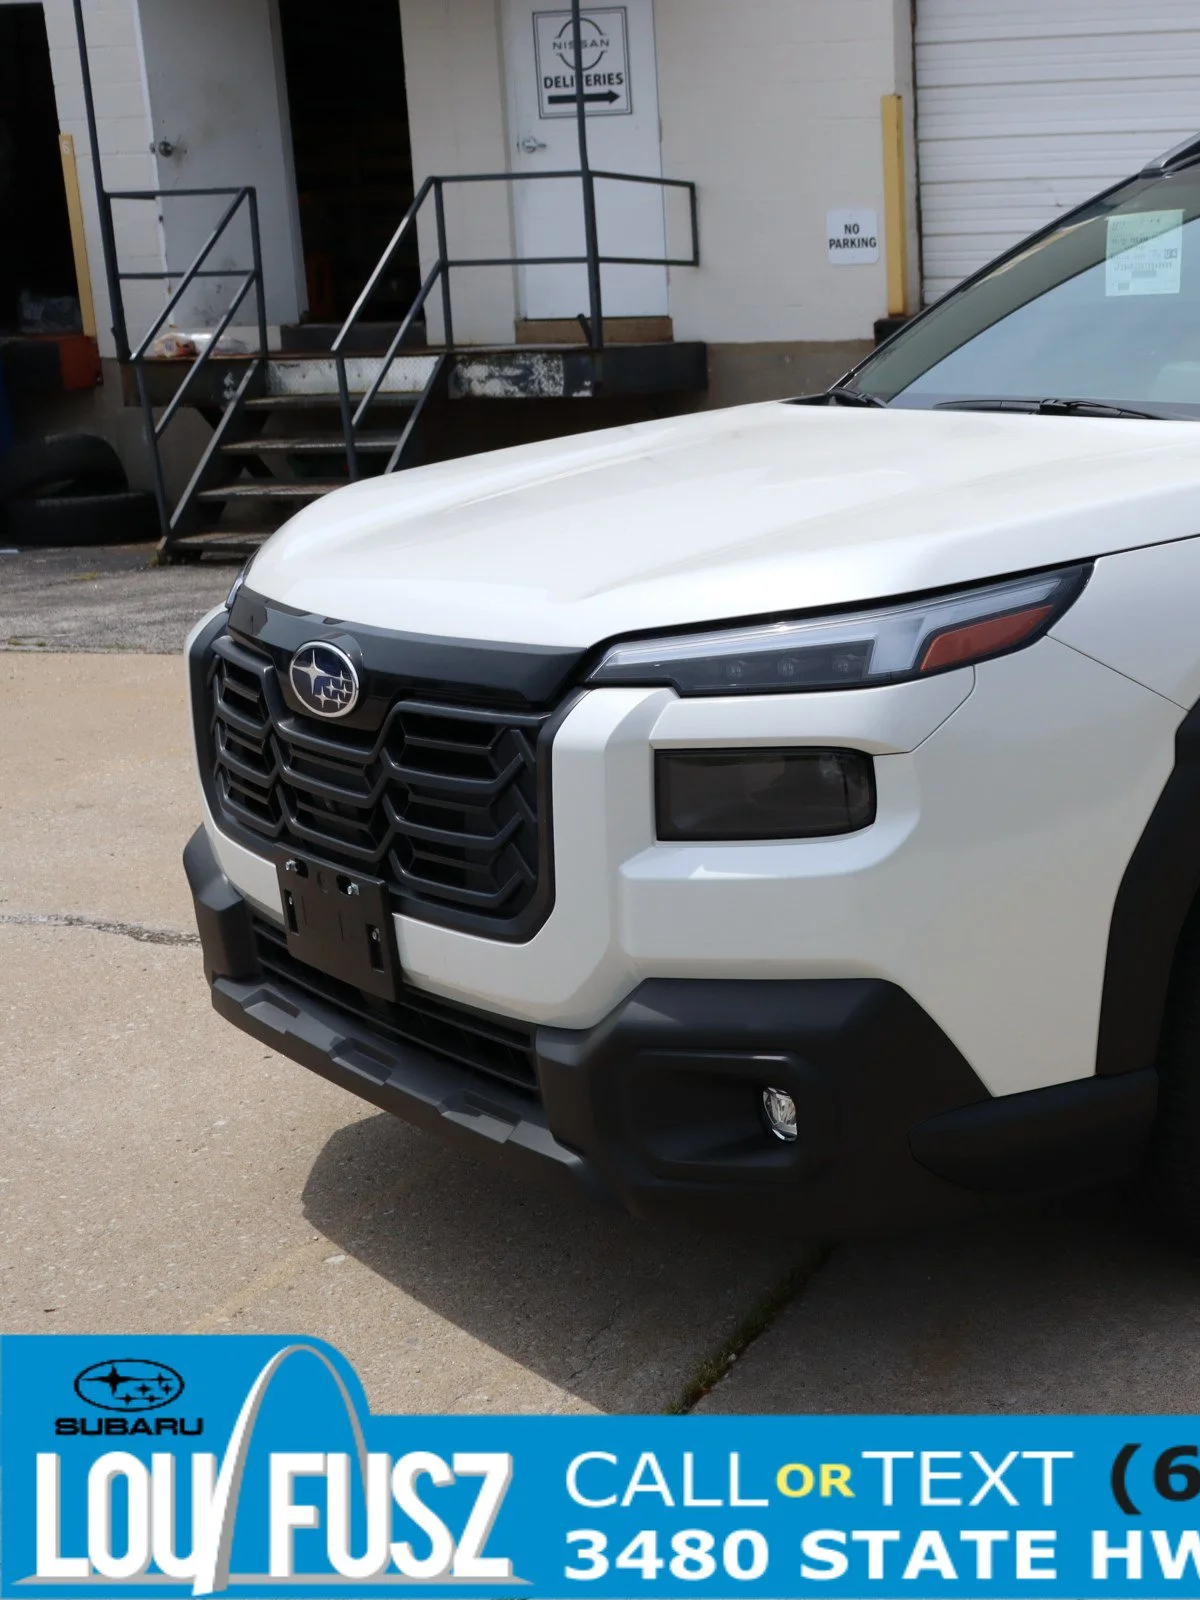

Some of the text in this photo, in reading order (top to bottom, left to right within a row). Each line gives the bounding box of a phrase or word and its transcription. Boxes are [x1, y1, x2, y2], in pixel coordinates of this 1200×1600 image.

[552, 39, 610, 50] NISSAN
[543, 72, 624, 89] DELIERIES
[844, 223, 860, 235] NO
[828, 237, 877, 250] PARKING
